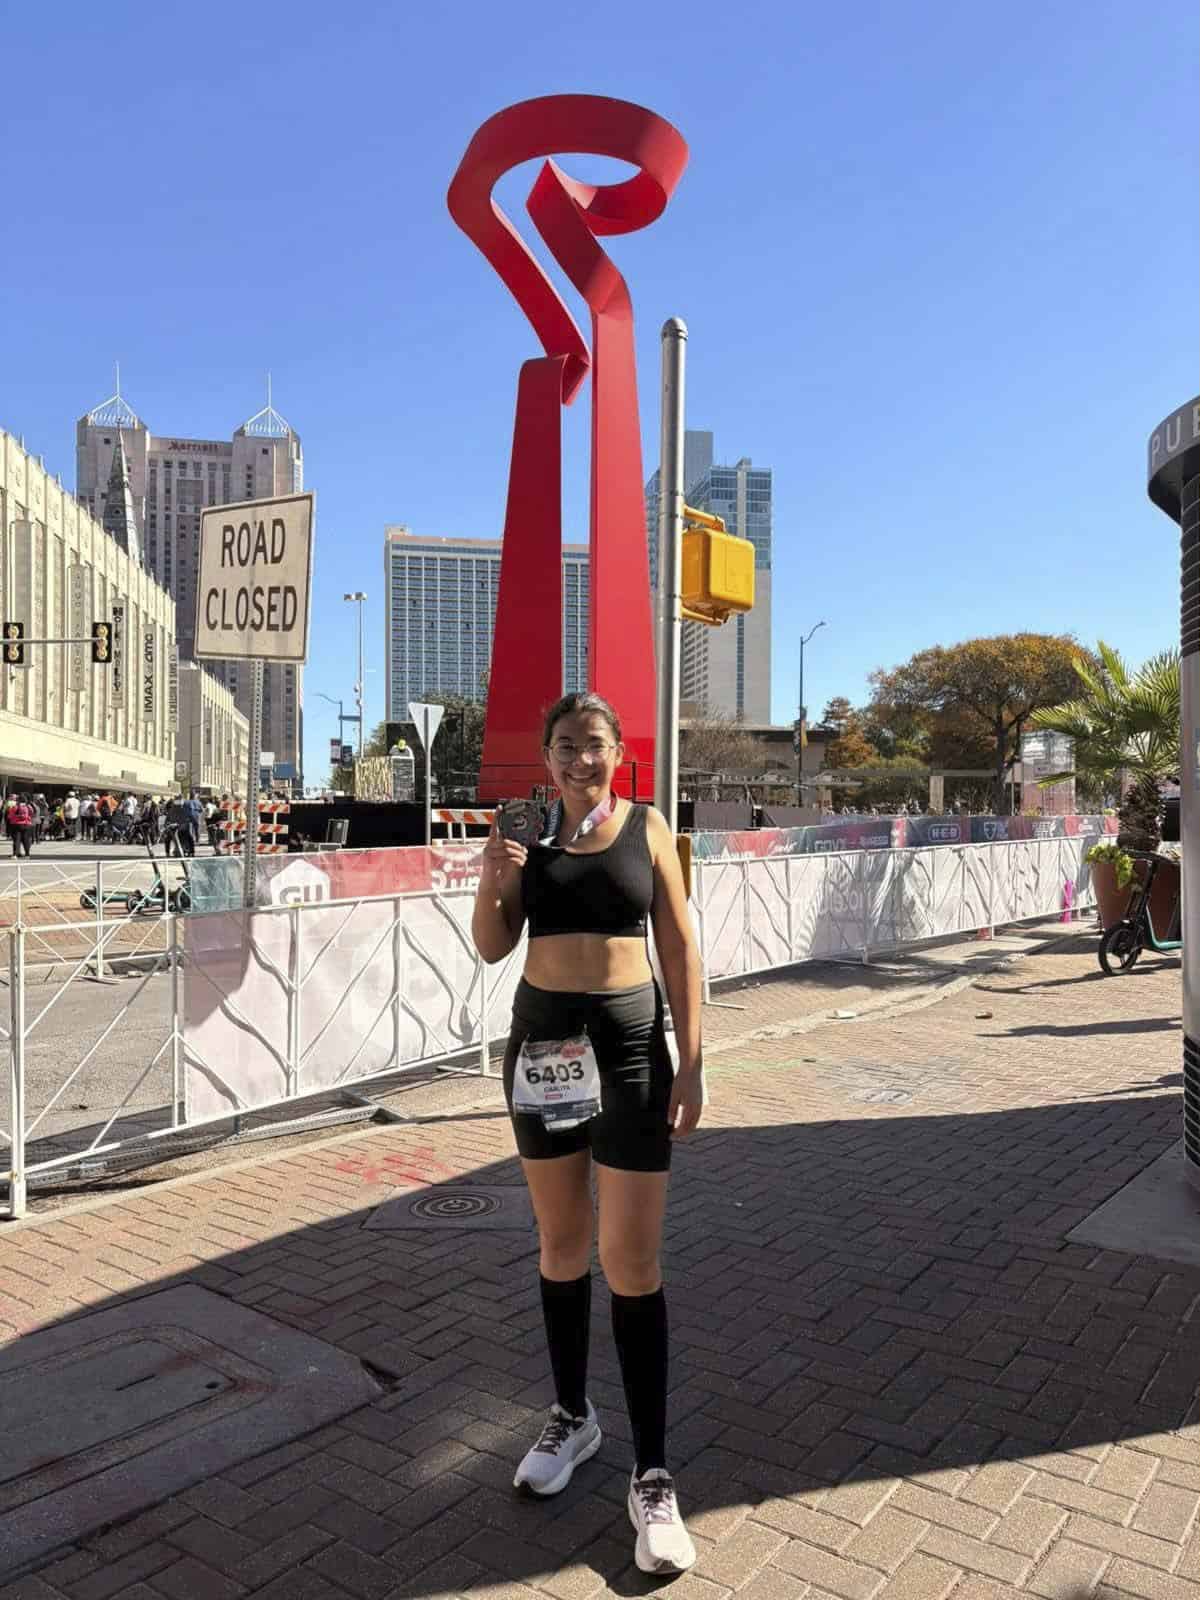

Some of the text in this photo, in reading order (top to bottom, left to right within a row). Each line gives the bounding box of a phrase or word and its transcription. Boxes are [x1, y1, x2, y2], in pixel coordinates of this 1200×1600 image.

[221, 518, 286, 567] ROAD
[206, 586, 297, 631] CLOSED
[144, 675, 153, 712] IMAX
[526, 1060, 585, 1085] 6403
